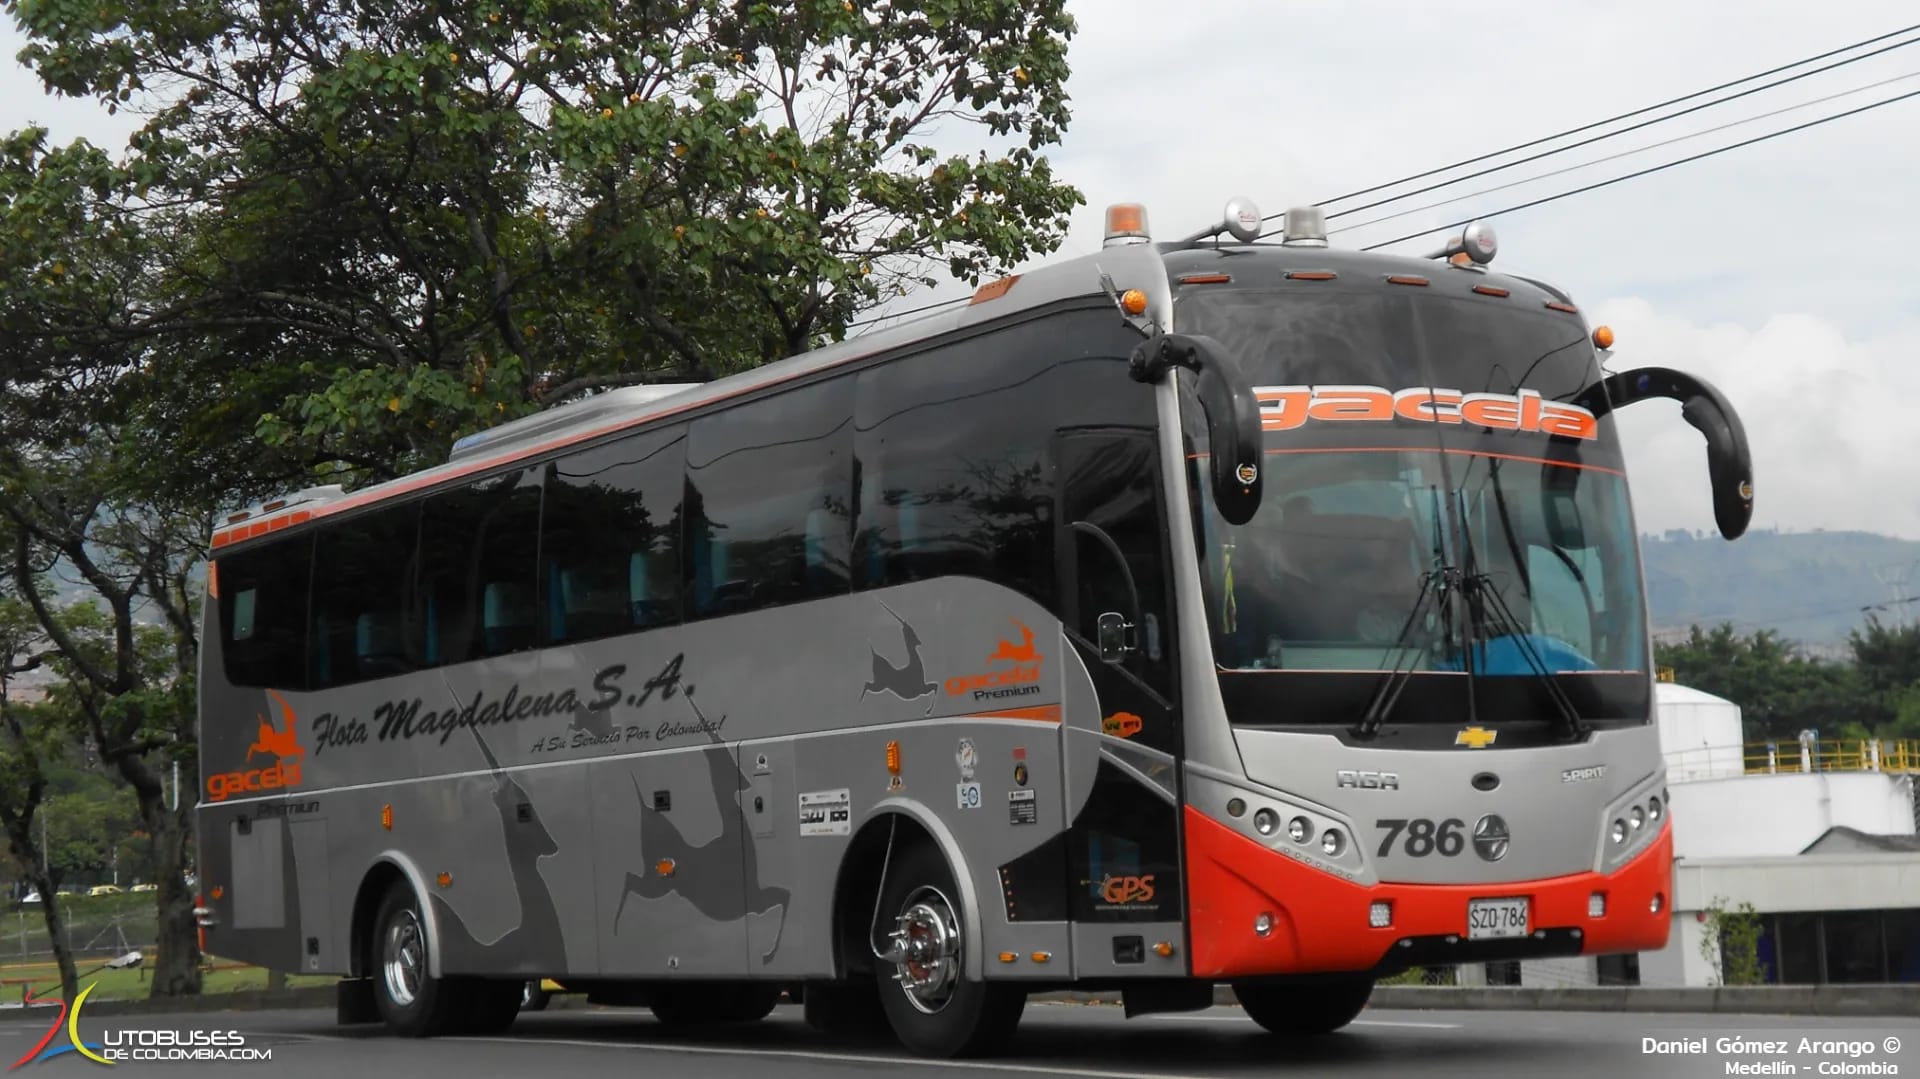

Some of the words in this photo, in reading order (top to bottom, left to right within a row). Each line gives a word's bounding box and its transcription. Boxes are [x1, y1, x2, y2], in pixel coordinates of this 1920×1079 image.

[1251, 385, 1597, 440] gacela
[943, 664, 1041, 698] gacela
[973, 684, 1041, 701] Premium
[312, 711, 369, 757] Flota
[373, 683, 577, 747] Magdalena
[588, 652, 696, 711] S.A.
[530, 736, 546, 753] A
[547, 736, 566, 752] Su
[625, 725, 650, 743] Por
[206, 758, 303, 803] gacela
[1337, 769, 1400, 791] AGA
[1560, 764, 1607, 784] SPIRIT
[1375, 818, 1466, 858] 786
[1103, 875, 1157, 904] GPS
